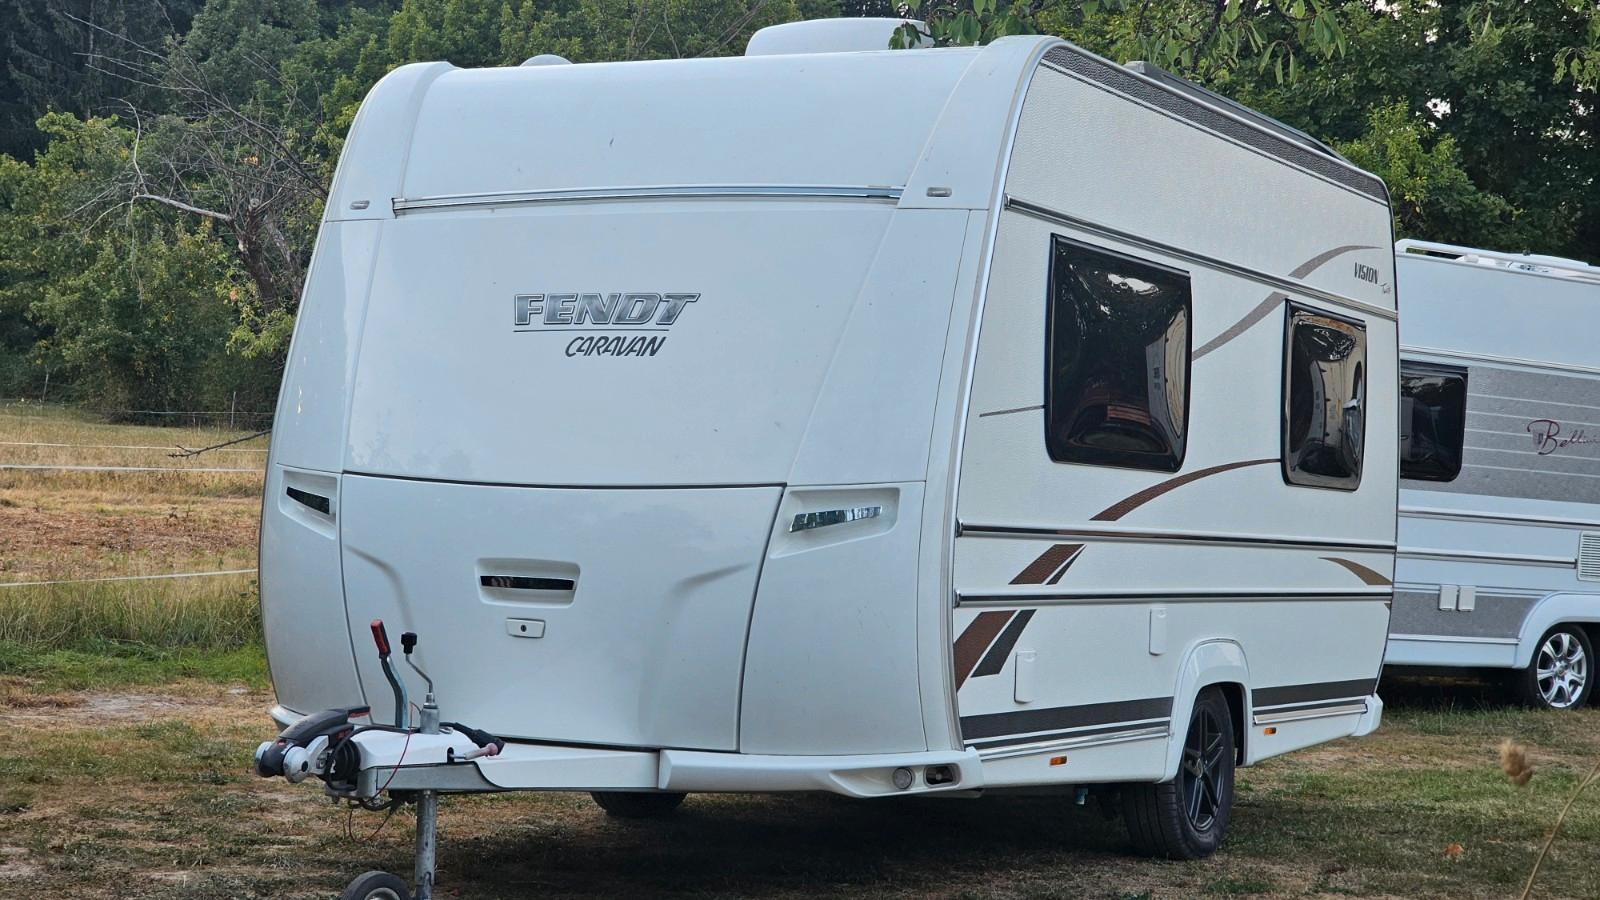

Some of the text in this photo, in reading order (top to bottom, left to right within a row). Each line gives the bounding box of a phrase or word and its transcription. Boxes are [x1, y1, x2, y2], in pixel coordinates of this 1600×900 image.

[1354, 262, 1379, 285] VISION
[514, 293, 701, 325] FENDT
[565, 336, 667, 357] CARAVAN
